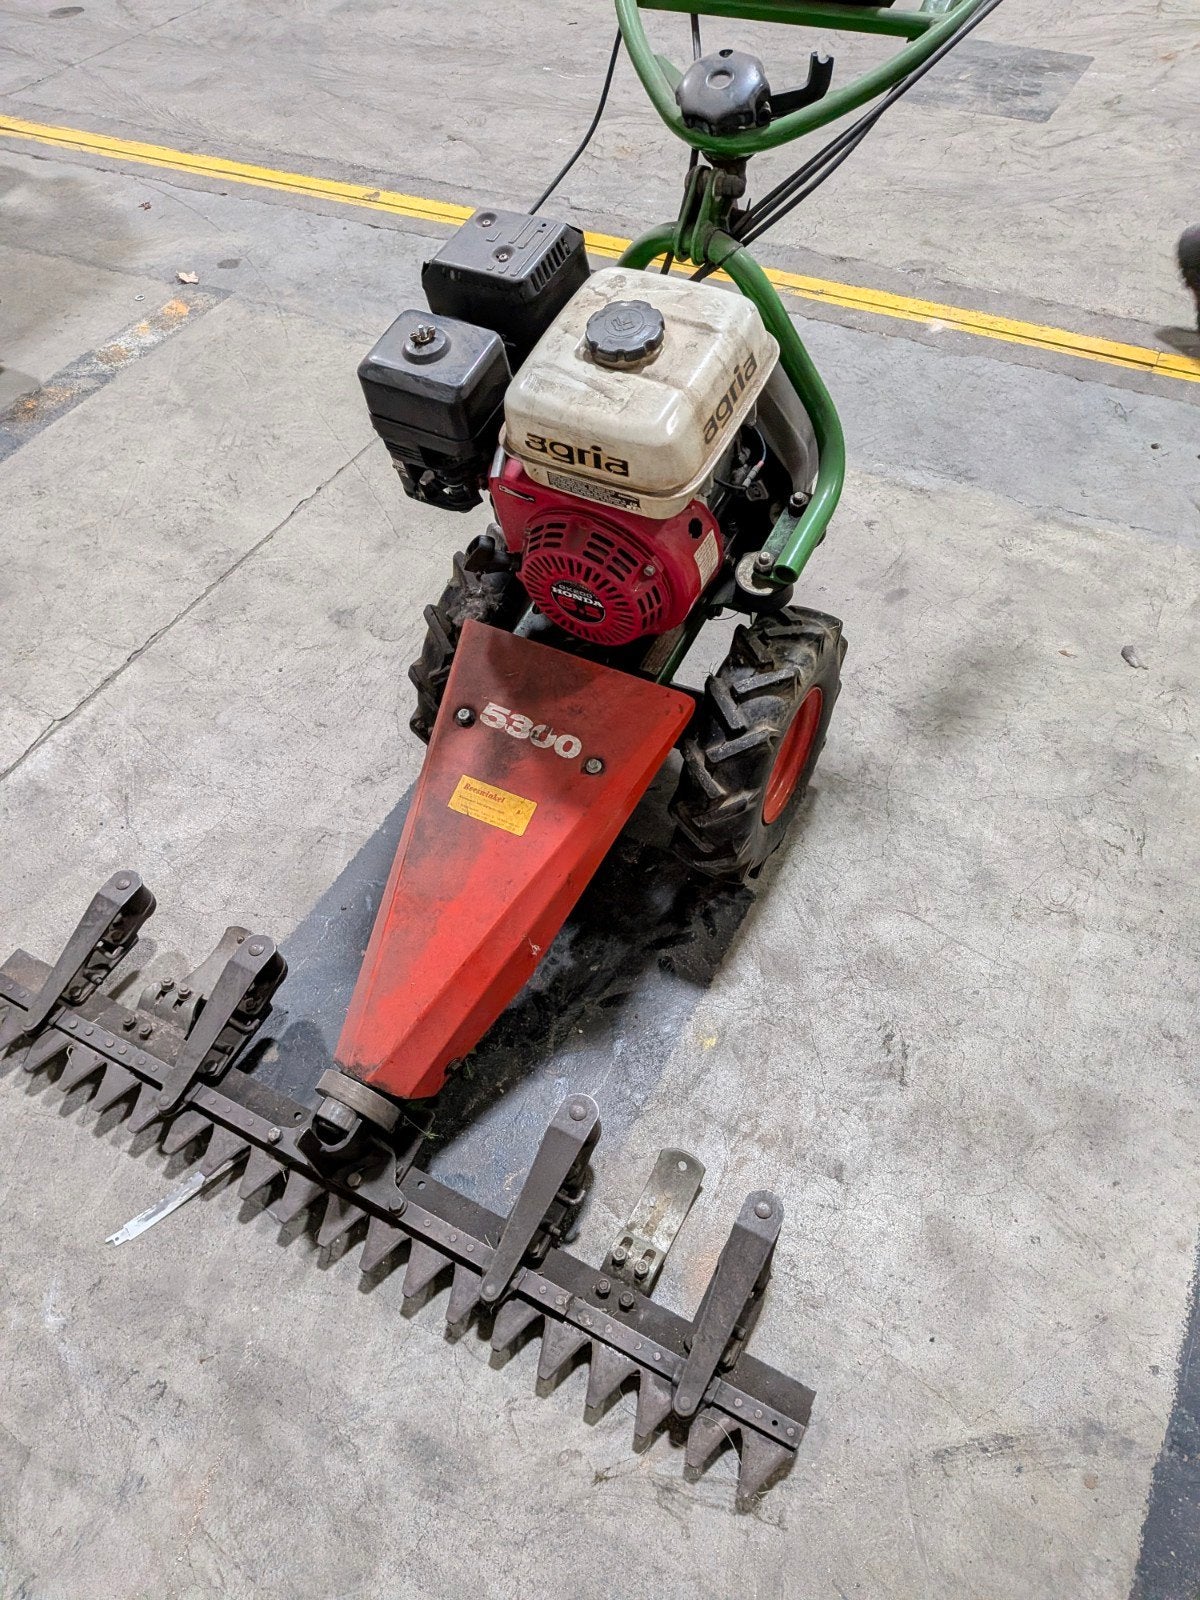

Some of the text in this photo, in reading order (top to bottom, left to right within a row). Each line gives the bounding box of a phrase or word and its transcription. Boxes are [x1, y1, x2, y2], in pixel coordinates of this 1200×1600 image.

[703, 352, 757, 444] agria
[525, 433, 629, 477] agria
[551, 586, 604, 609] HONDA
[480, 702, 582, 759] 5300
